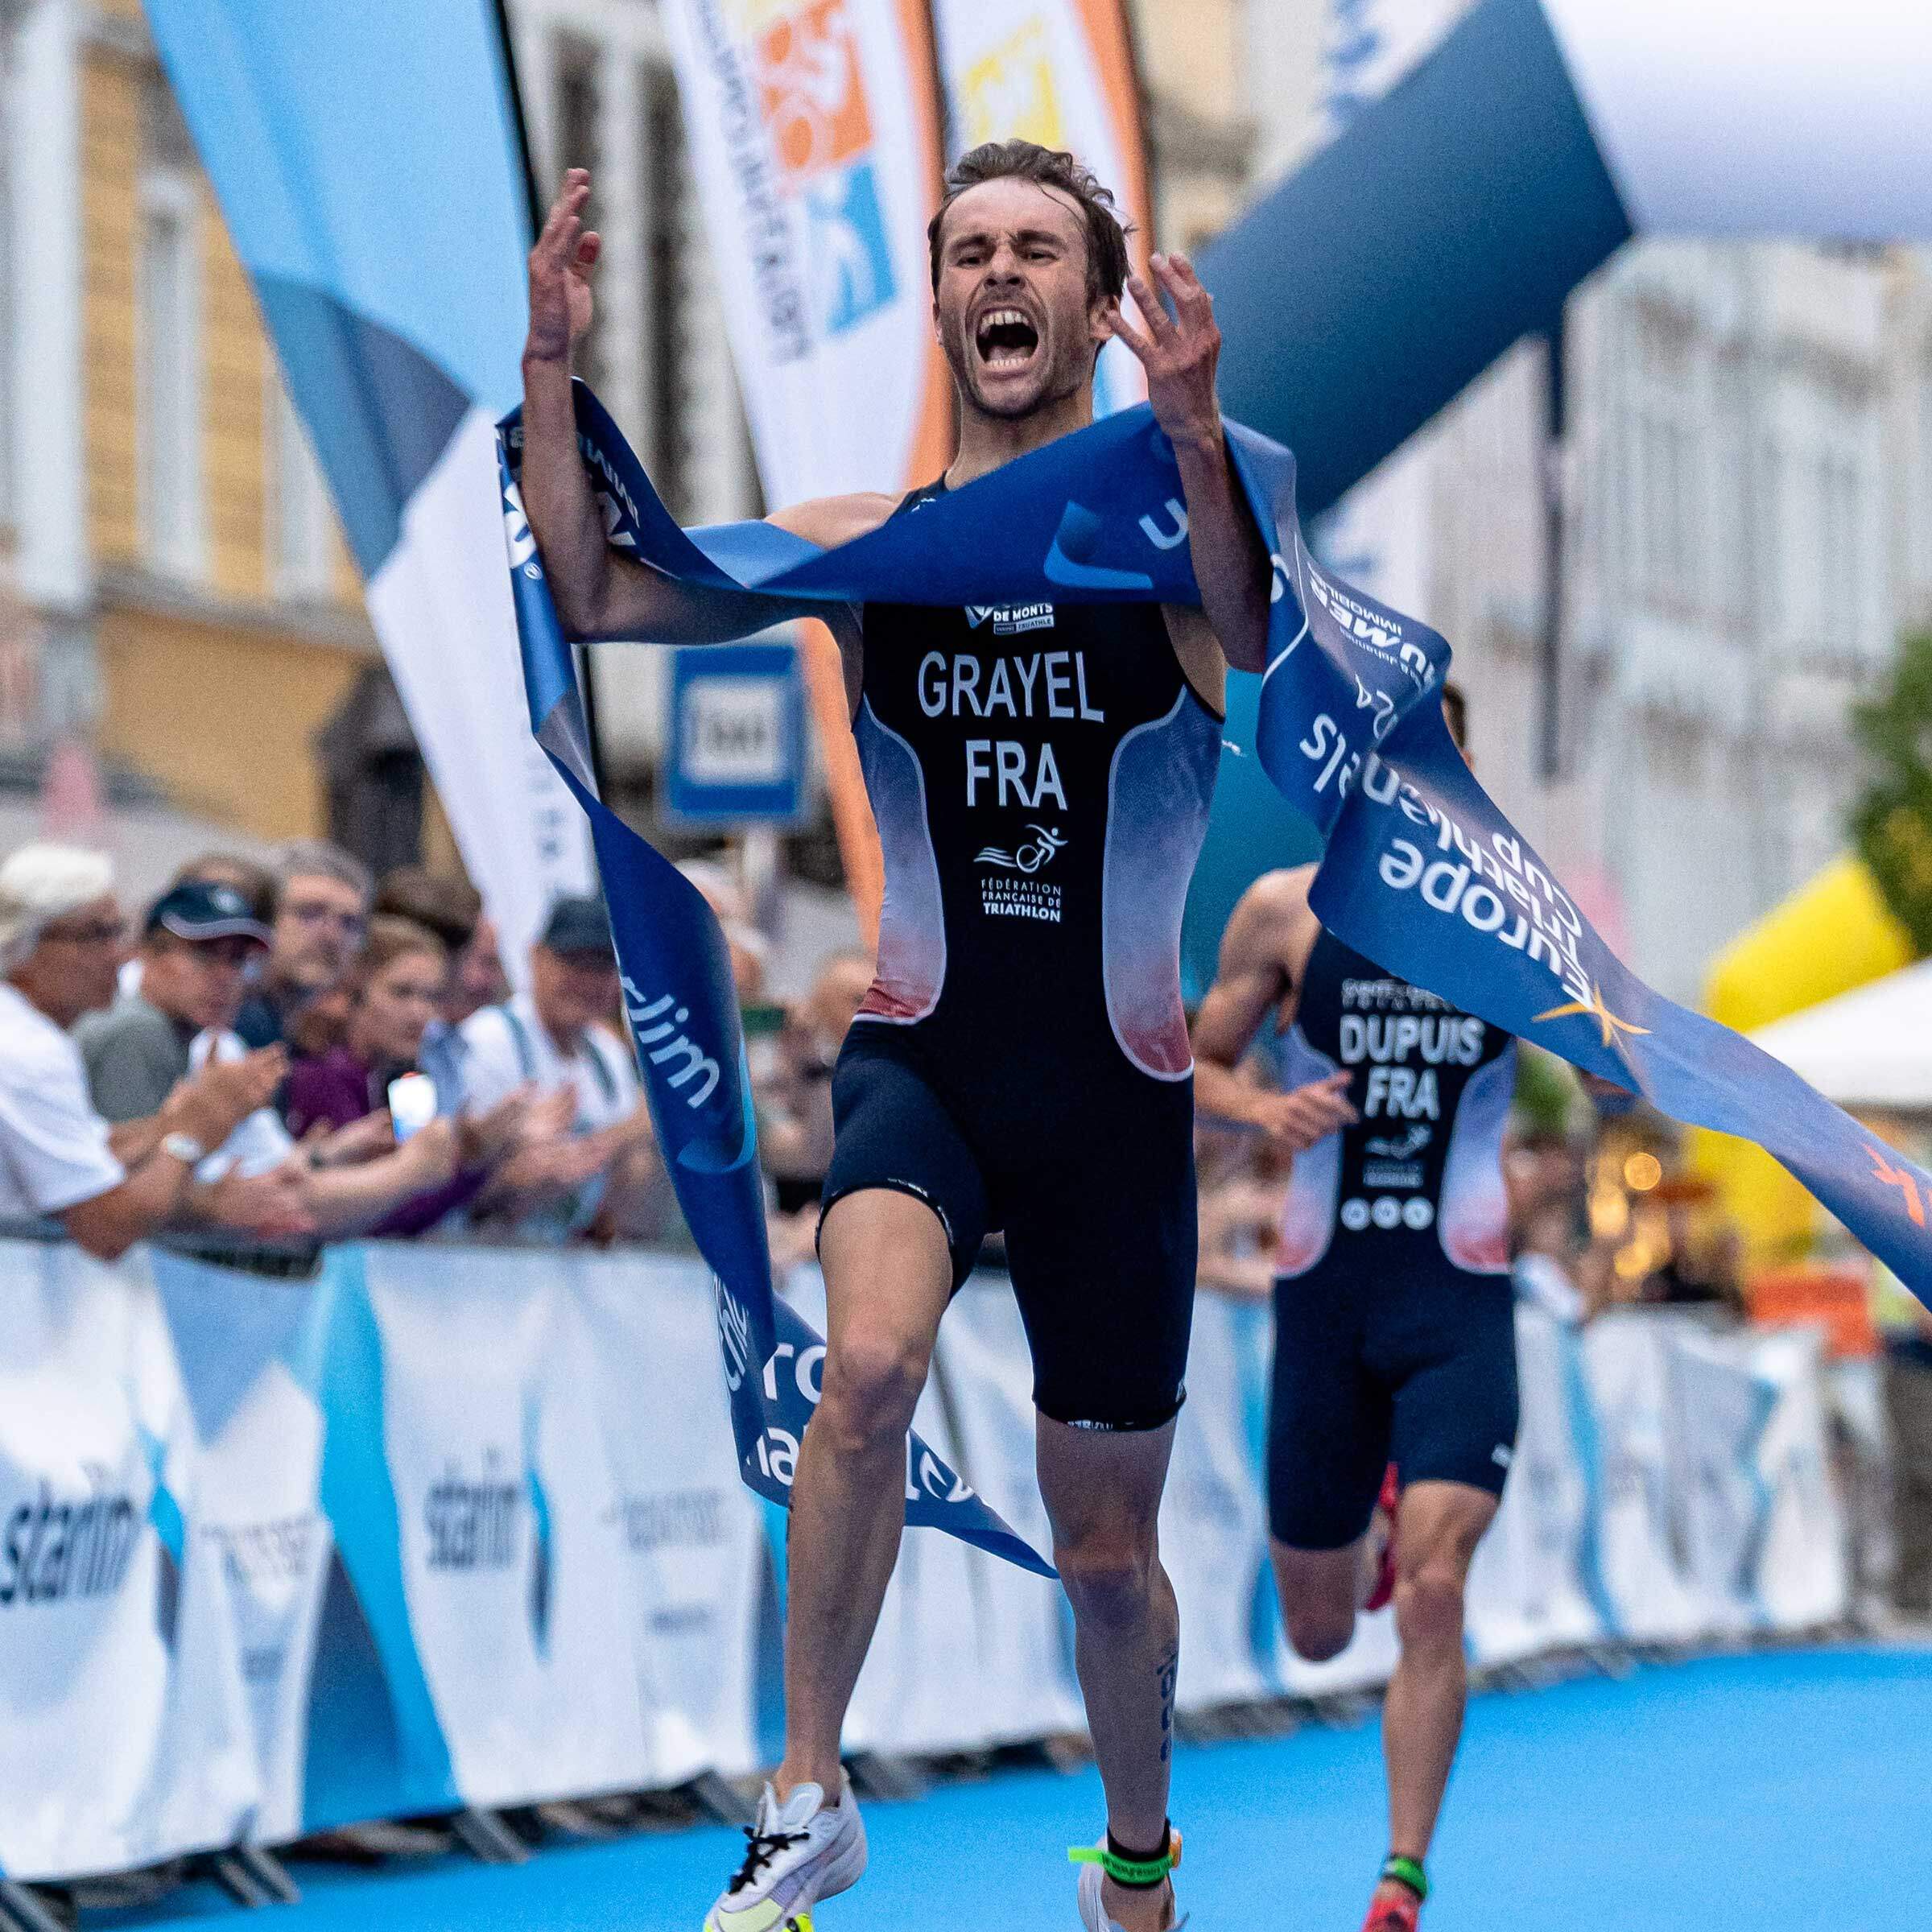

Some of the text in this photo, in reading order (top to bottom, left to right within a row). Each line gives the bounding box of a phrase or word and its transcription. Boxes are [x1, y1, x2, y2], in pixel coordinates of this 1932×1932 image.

[993, 602, 1053, 622] DE MONTS
[918, 650, 1104, 723] GRAYEL
[966, 739, 1068, 811] FRA
[983, 902, 1061, 923] TRIATHLON
[1047, 897, 1061, 909] DE
[1492, 832, 1583, 938] Cup
[1378, 837, 1594, 1009] Europe
[1340, 1013, 1486, 1066] DUPUIS
[1364, 1065, 1440, 1121] FRA
